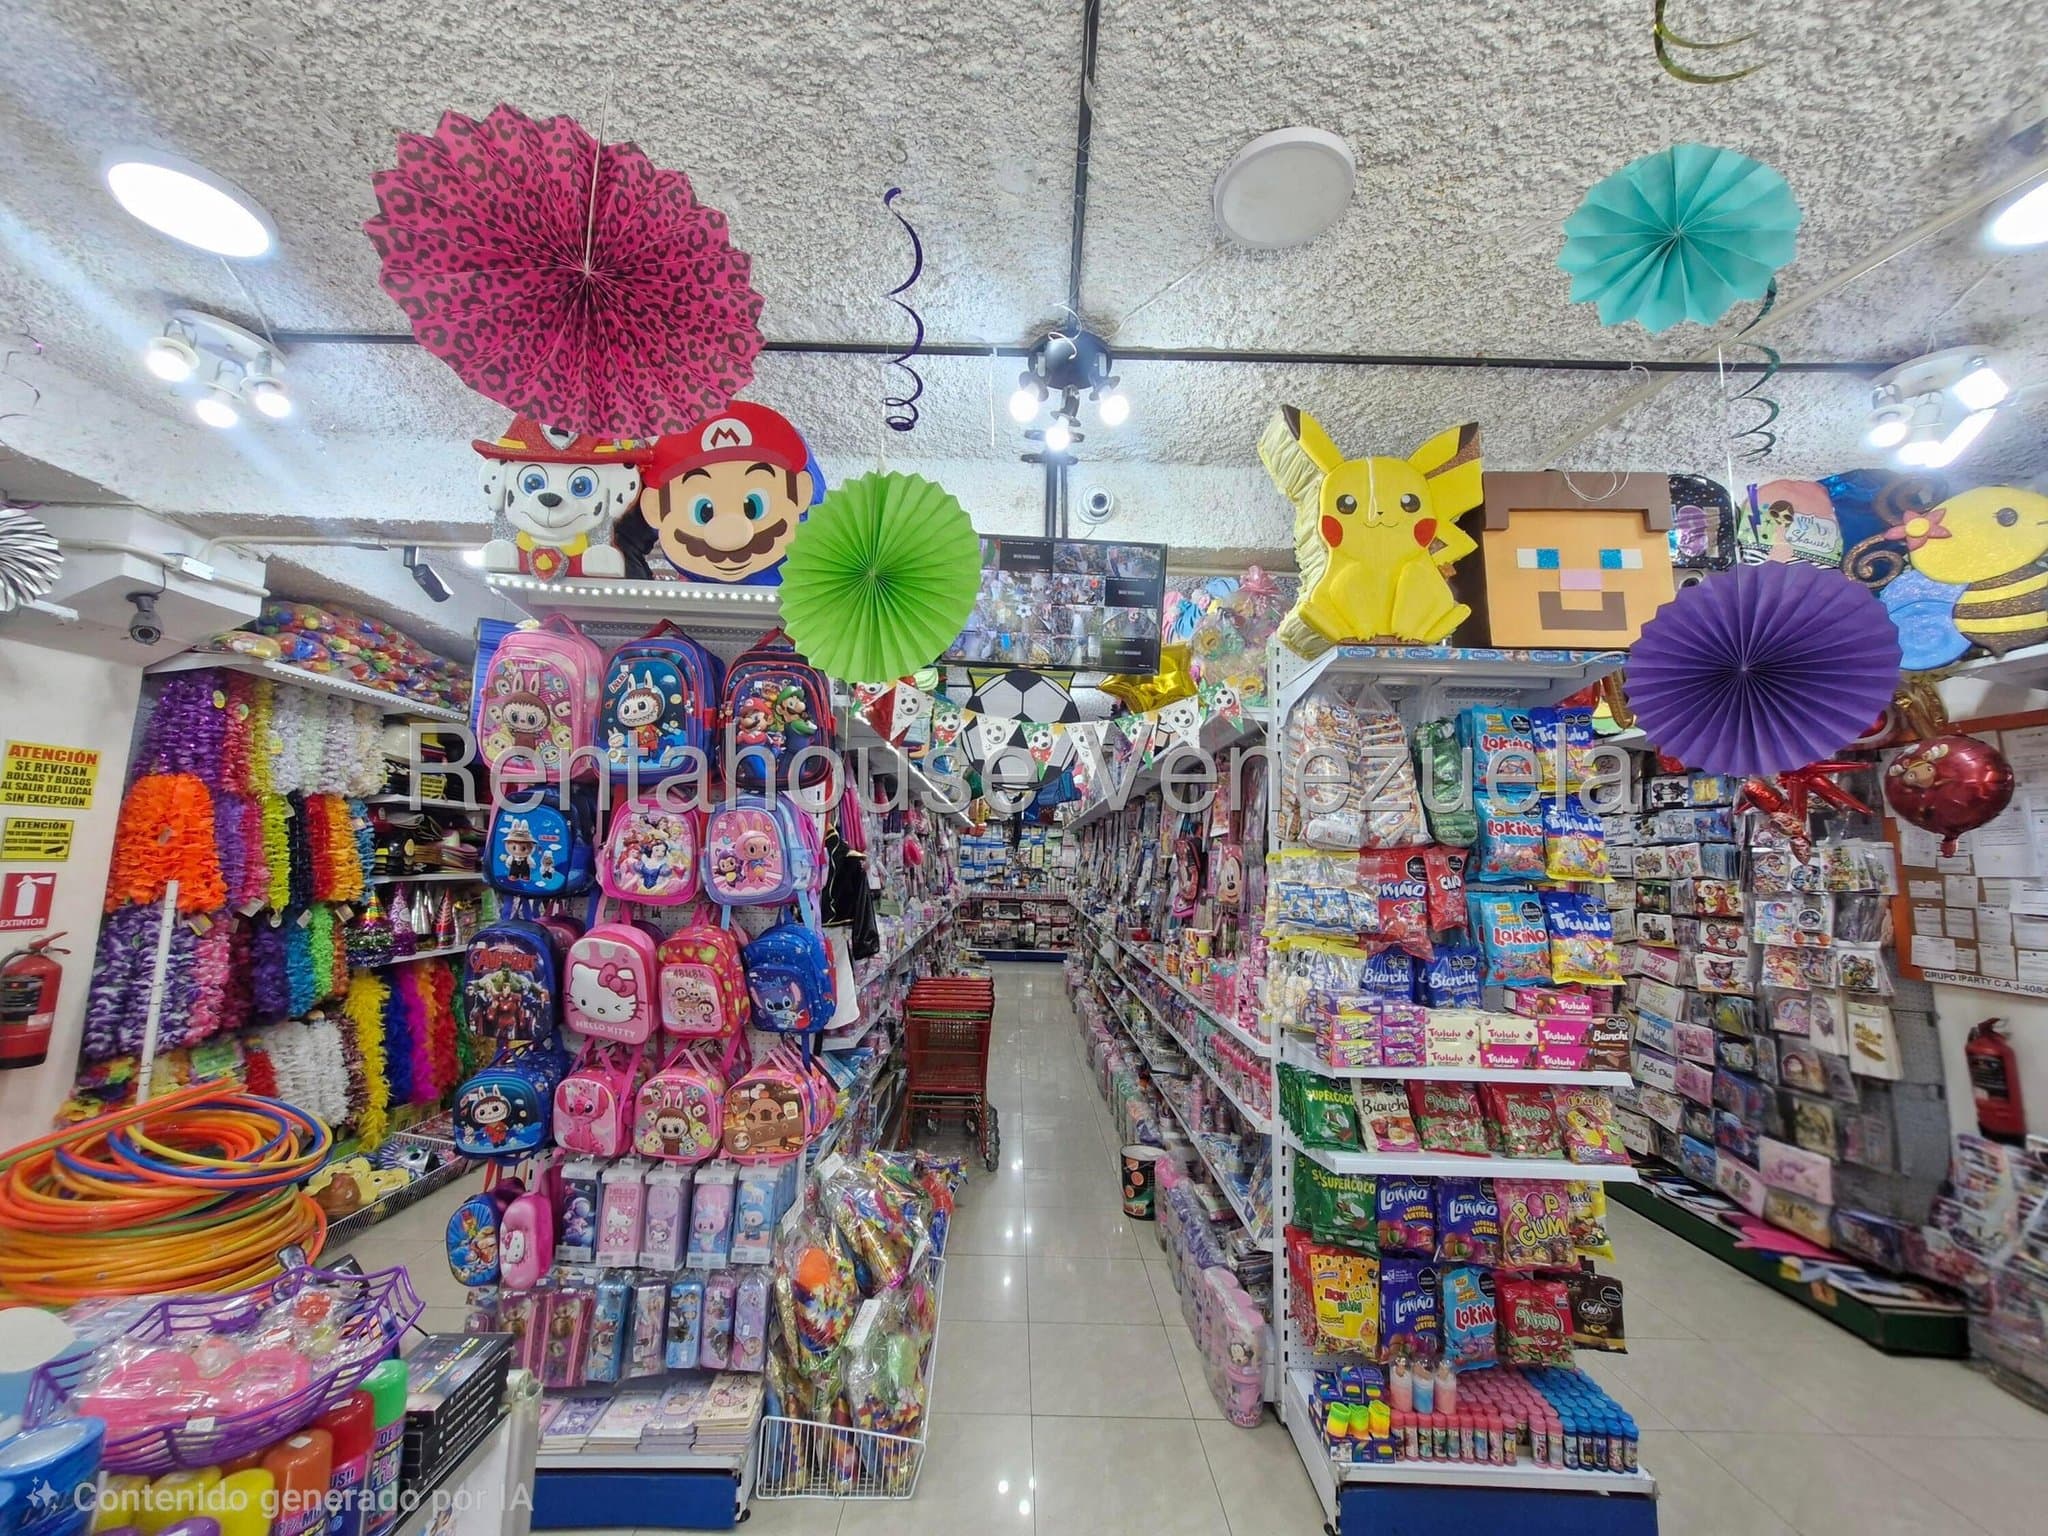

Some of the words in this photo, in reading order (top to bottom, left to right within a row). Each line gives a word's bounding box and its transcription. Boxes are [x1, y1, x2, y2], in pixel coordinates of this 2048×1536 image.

[711, 427, 741, 447] M
[8, 744, 98, 765] ATENCIÓN
[15, 761, 31, 772] SE
[34, 763, 88, 777] REVISAN
[6, 771, 46, 783] BOLSAS
[47, 775, 55, 783] Y
[55, 776, 93, 787] BOLSOS
[1, 781, 12, 790] AL
[15, 782, 45, 793] SALIR
[46, 785, 63, 794] DEL
[65, 786, 93, 796] LOCAL
[5, 793, 25, 803] SIN
[27, 794, 87, 807] EXCEPCIÓN
[13, 821, 68, 830] ATENCIÓN
[0, 918, 45, 928] EXTINTOR
[1551, 914, 1612, 933] Trululu
[1363, 968, 1409, 983] Bianchi
[1429, 970, 1478, 988] Bianchi
[1924, 970, 1957, 982] GRUPO
[1558, 999, 1590, 1011] Trululu
[576, 1020, 605, 1032] HELLO
[606, 1025, 636, 1039] KITTY
[1428, 1028, 1461, 1038] Trululu
[1488, 1029, 1520, 1039] Trululu
[1542, 1030, 1576, 1041] Trululu
[1593, 1030, 1629, 1042] Bianchi
[1431, 1052, 1463, 1062] Trululu
[1486, 1054, 1519, 1065] Trululu
[1544, 1055, 1576, 1067] Trululu
[1362, 1098, 1409, 1116] Bianchi
[1322, 1177, 1376, 1195] SUPERCOCO
[1380, 1186, 1428, 1211] LOKIÑO
[1450, 1199, 1497, 1224] LOKIÑO
[1519, 1215, 1568, 1248] GUM
[1395, 1296, 1434, 1324] LOKIÑO
[1580, 1300, 1609, 1315] Coffee
